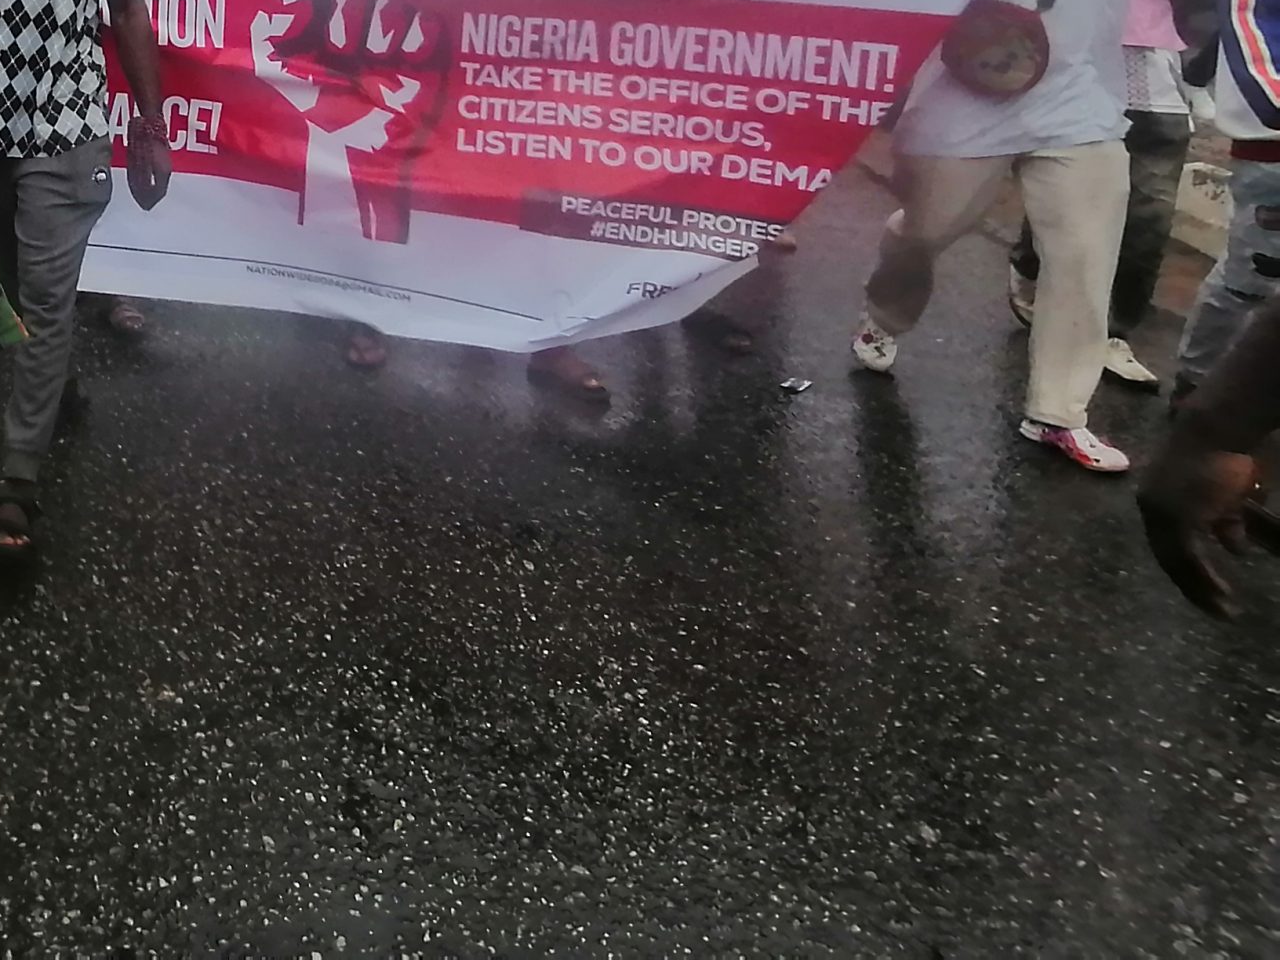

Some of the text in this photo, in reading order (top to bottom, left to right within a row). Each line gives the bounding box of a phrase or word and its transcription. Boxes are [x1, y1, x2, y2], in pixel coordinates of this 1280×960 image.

[461, 11, 899, 93] NIGERIA GOVERNMENT!
[458, 95, 772, 153] CITIZENS SERIOUS,
[459, 61, 892, 127] TAKE THE OFFICE OF THE
[456, 127, 831, 192] LISTEN TO OUR DEMA
[561, 195, 784, 242] PEACEFUL PROTES
